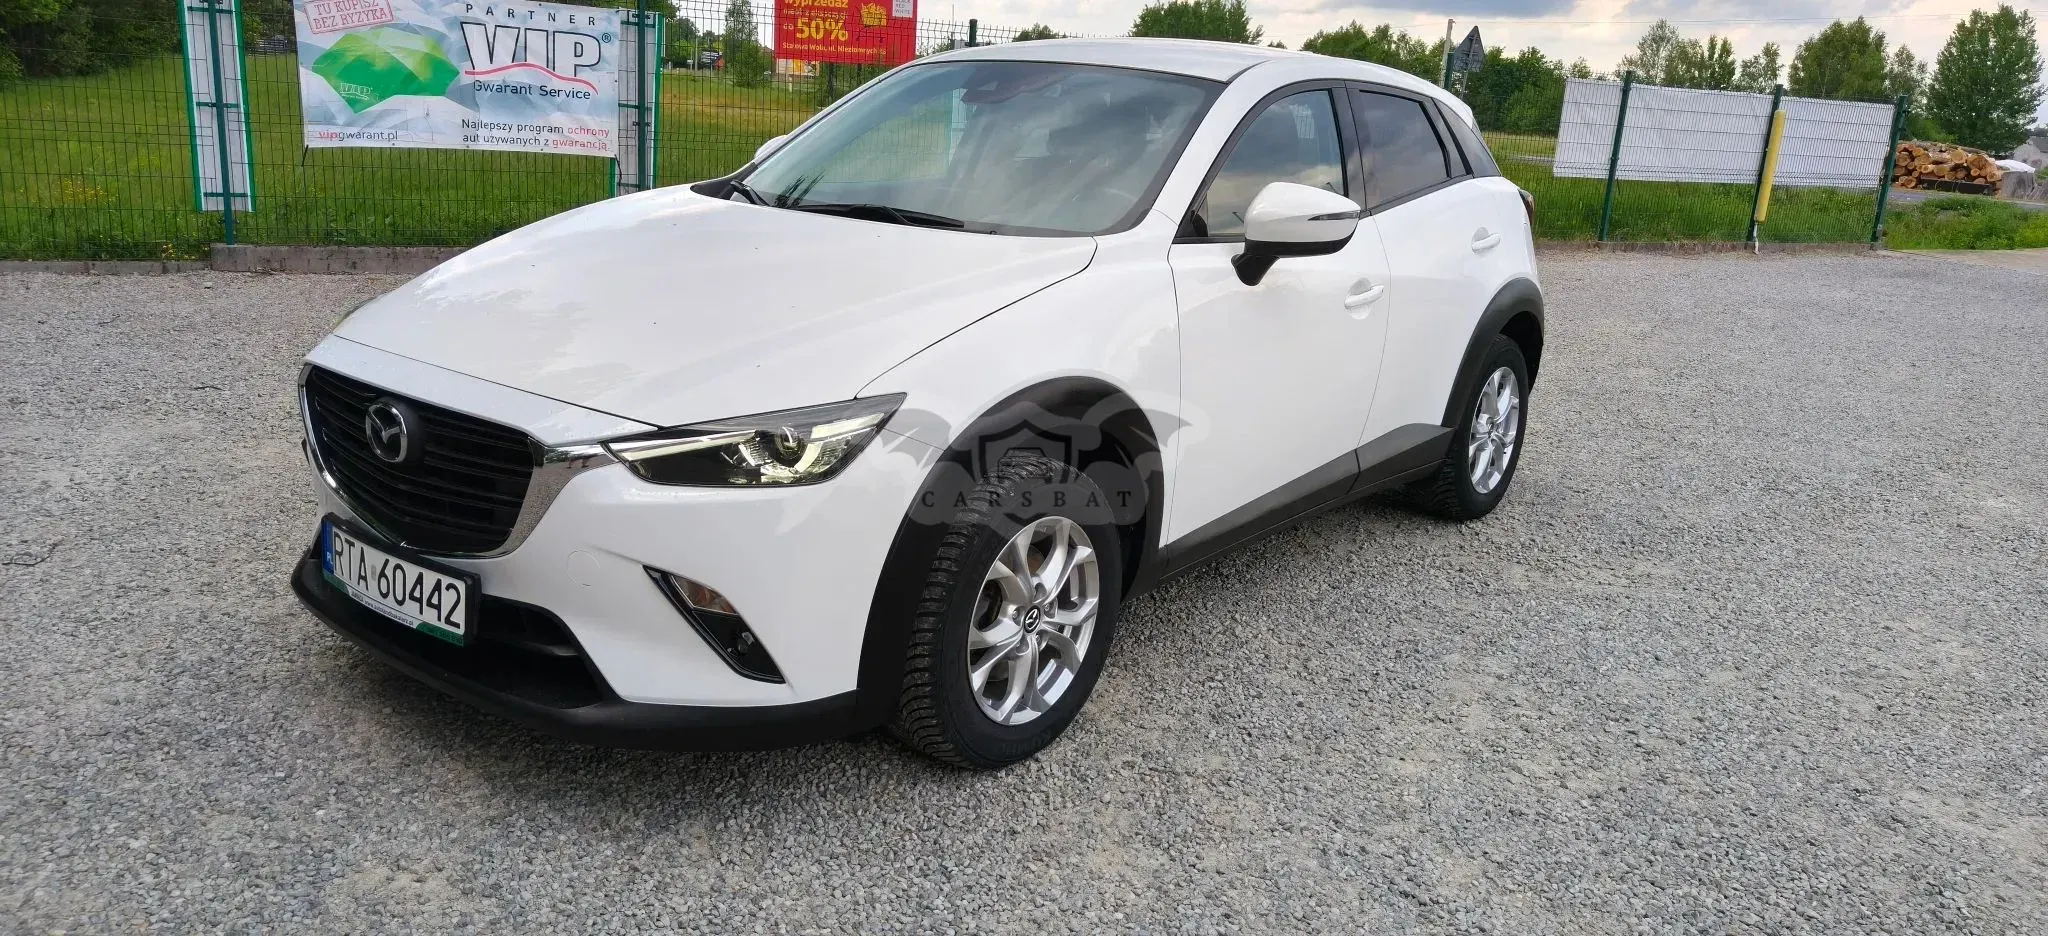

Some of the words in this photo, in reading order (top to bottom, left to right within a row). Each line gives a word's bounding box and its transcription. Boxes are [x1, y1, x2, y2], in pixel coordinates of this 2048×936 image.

[313, 15, 338, 30] BEZ
[340, 7, 387, 26] RYZYKA
[314, 2, 331, 16] TU
[466, 3, 596, 27] PARTNER
[796, 17, 849, 41] 50%
[460, 21, 602, 78] VIP
[474, 79, 533, 97] Gwarant
[539, 85, 591, 101] Service
[318, 130, 399, 143] vipgwarant.pl
[461, 118, 513, 132] Najlepszy
[517, 123, 564, 135] program
[567, 127, 610, 138] ochrony
[462, 133, 480, 143] aut
[483, 133, 541, 147] używanych
[543, 138, 549, 146] z
[333, 530, 369, 592] RTA
[377, 558, 461, 630] 60442
